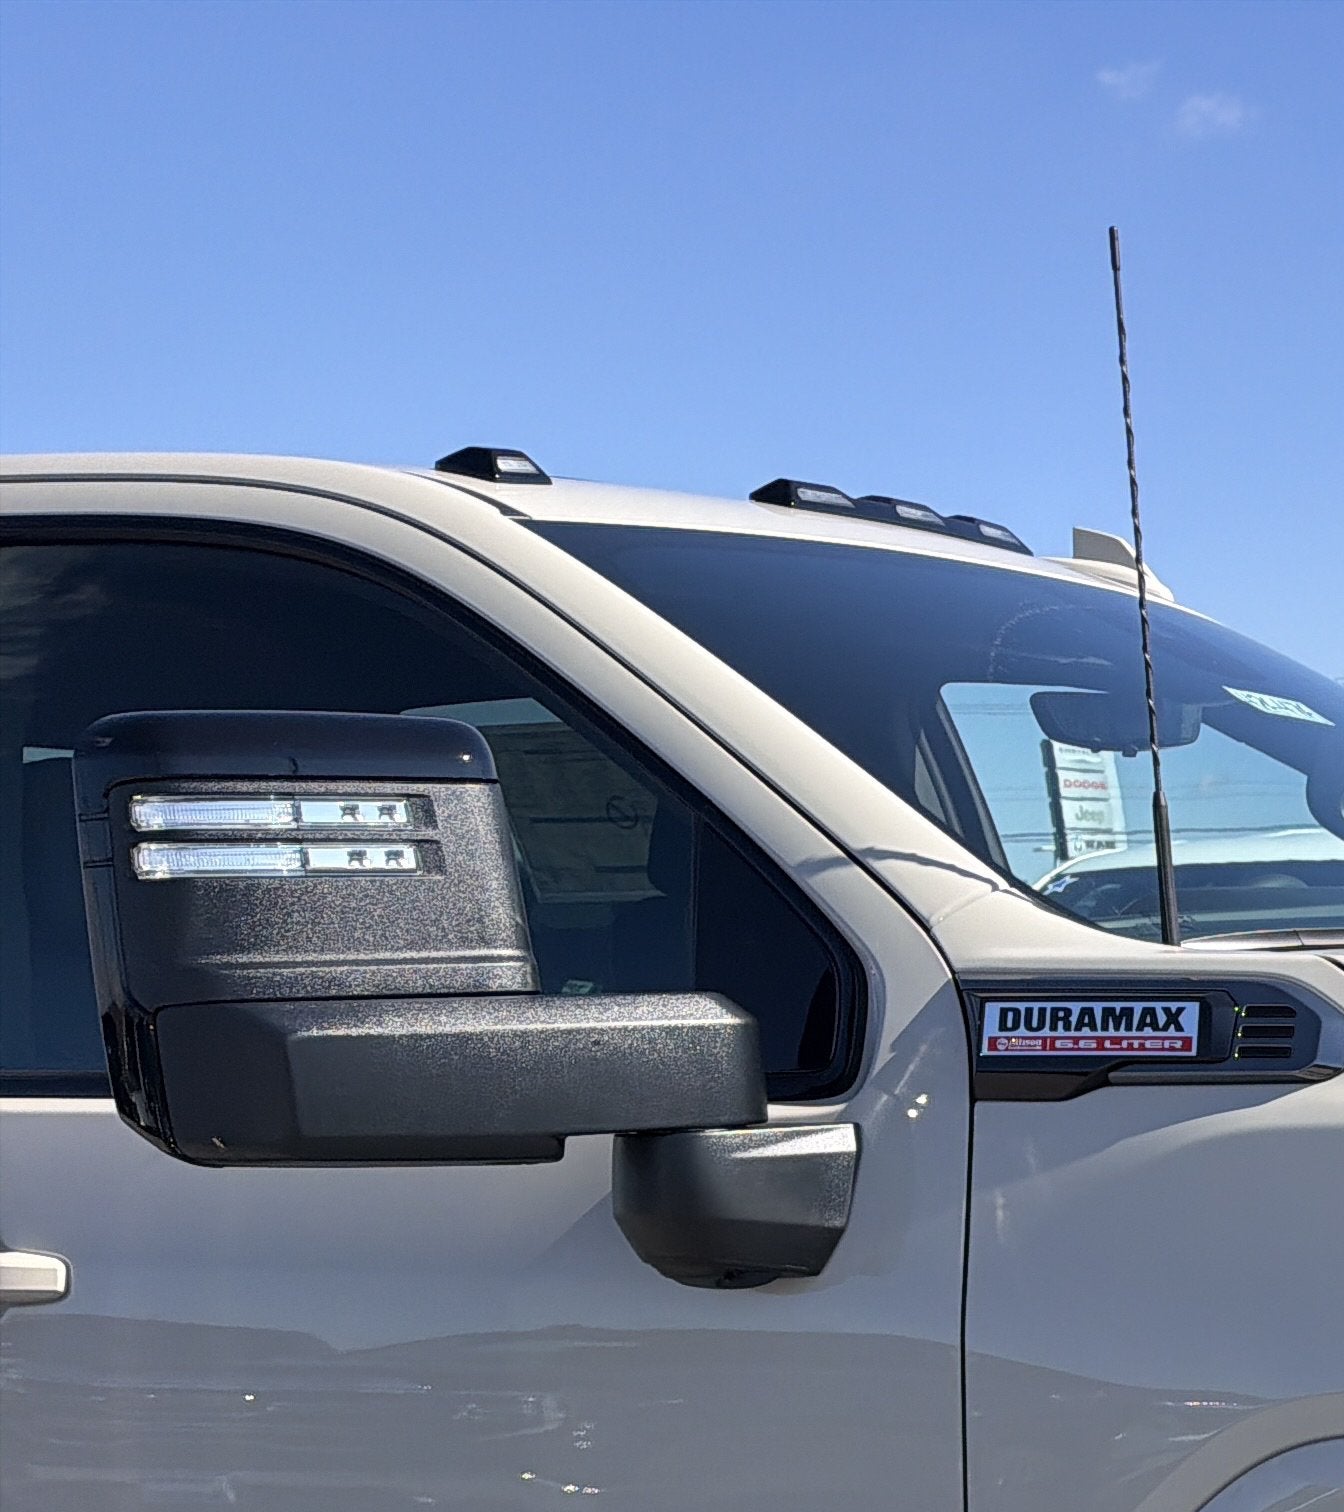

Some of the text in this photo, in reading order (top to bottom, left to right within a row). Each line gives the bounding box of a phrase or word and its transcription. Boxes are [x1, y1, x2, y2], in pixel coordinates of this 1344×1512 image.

[998, 1006, 1187, 1033] DURAMAX
[1055, 1039, 1184, 1049] 6.6 LITER
